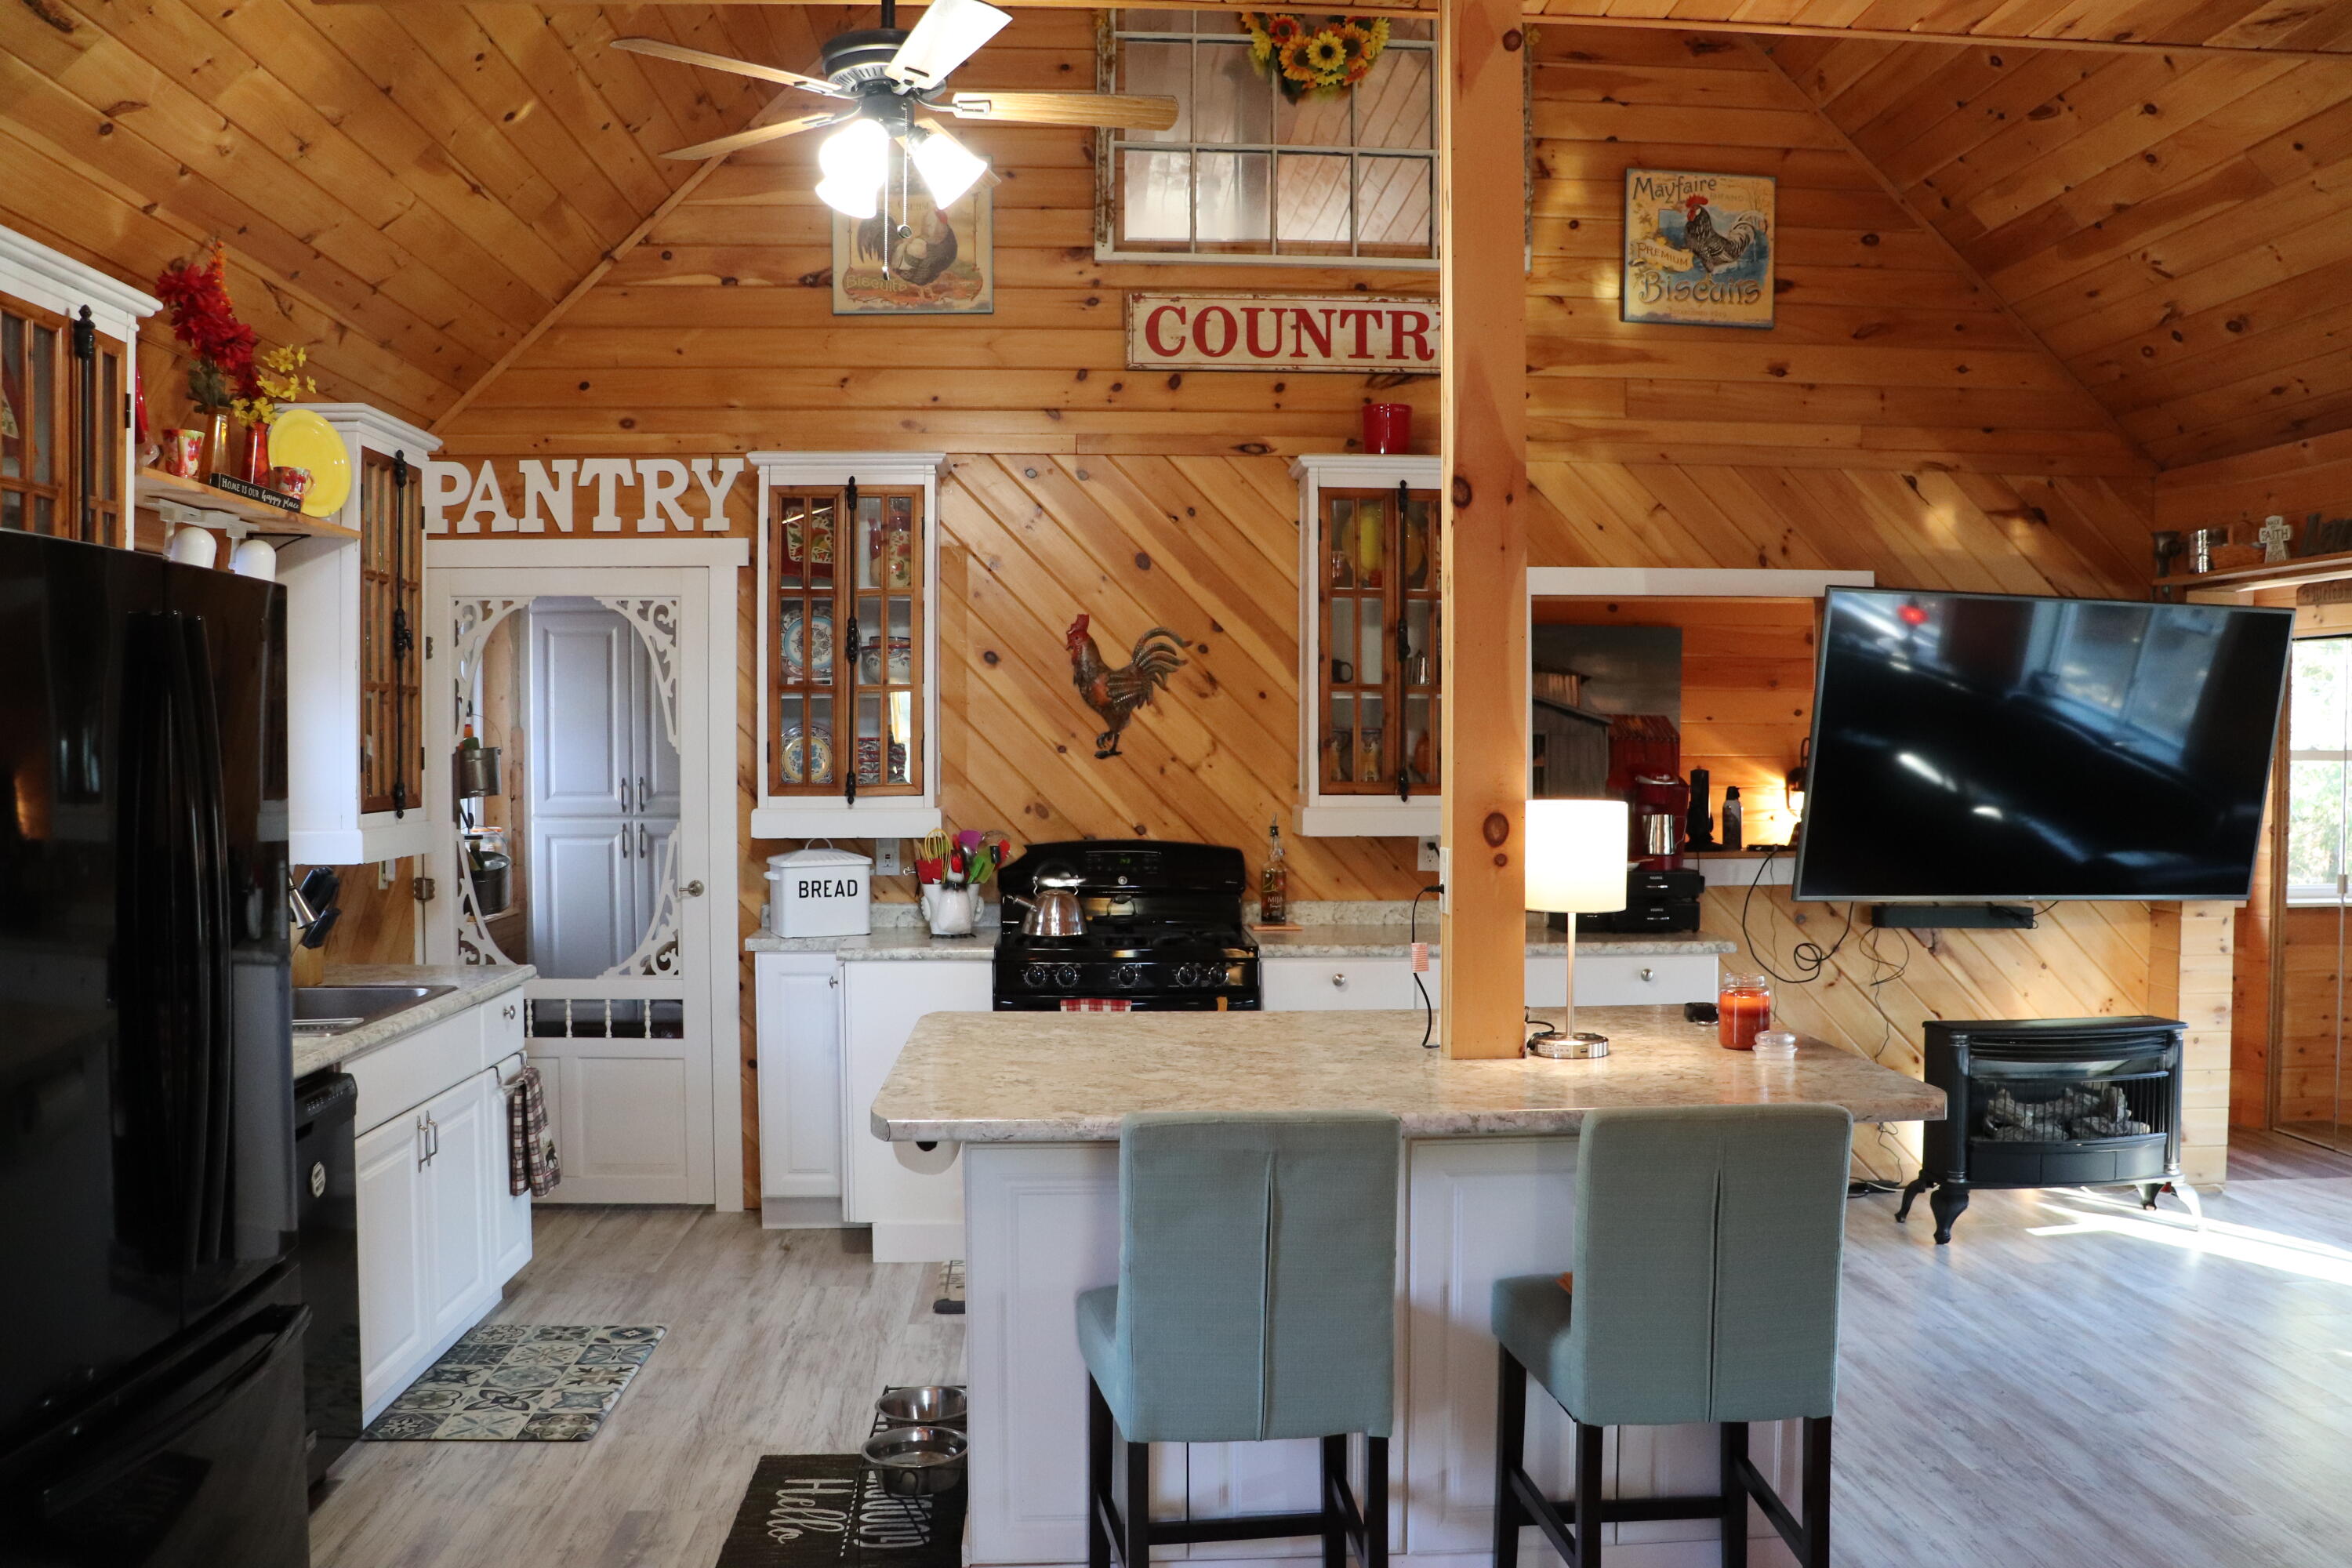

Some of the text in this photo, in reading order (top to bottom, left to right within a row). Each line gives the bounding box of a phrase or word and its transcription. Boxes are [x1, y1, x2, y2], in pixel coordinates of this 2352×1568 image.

[1632, 176, 1717, 204] Mayfaire
[1636, 242, 1689, 267] PREMIUM
[1639, 270, 1761, 305] Biscuits
[1145, 305, 1440, 361] COUNTR
[221, 477, 299, 510] HOME IS OUR happy place
[426, 458, 745, 534] PANTRY
[2261, 528, 2288, 542] FAITH
[798, 880, 858, 898] BREAD
[765, 1478, 855, 1544] Hello
